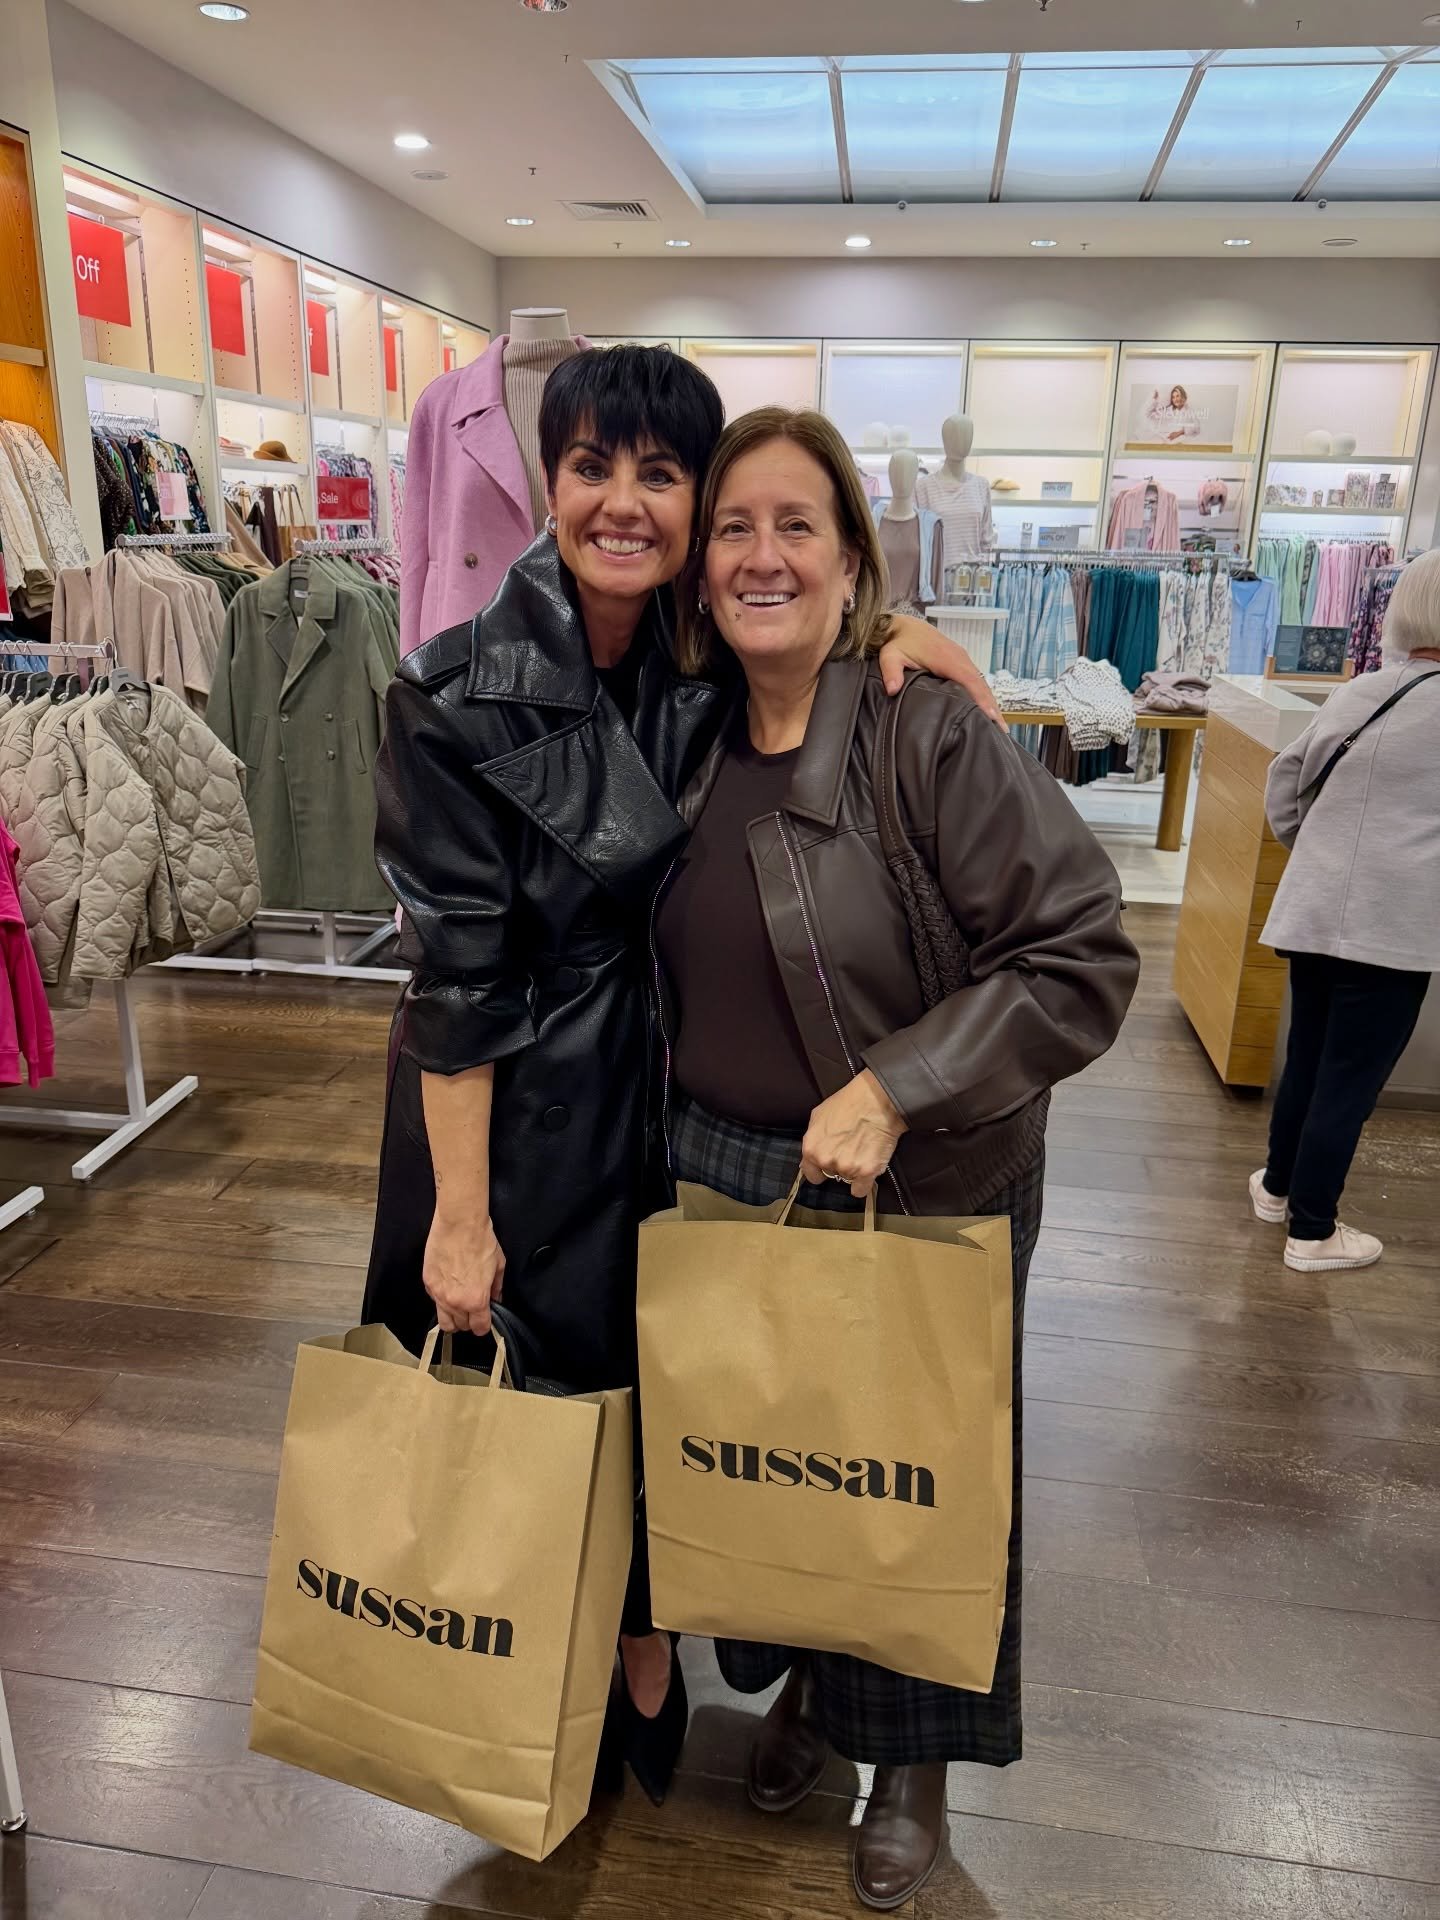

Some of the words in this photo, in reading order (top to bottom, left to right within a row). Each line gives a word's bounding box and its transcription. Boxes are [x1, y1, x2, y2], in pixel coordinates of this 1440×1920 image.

[76, 255, 100, 284] Off
[320, 492, 338, 504] Sale
[681, 1435, 939, 1509] sussan
[296, 1559, 515, 1658] sussan
